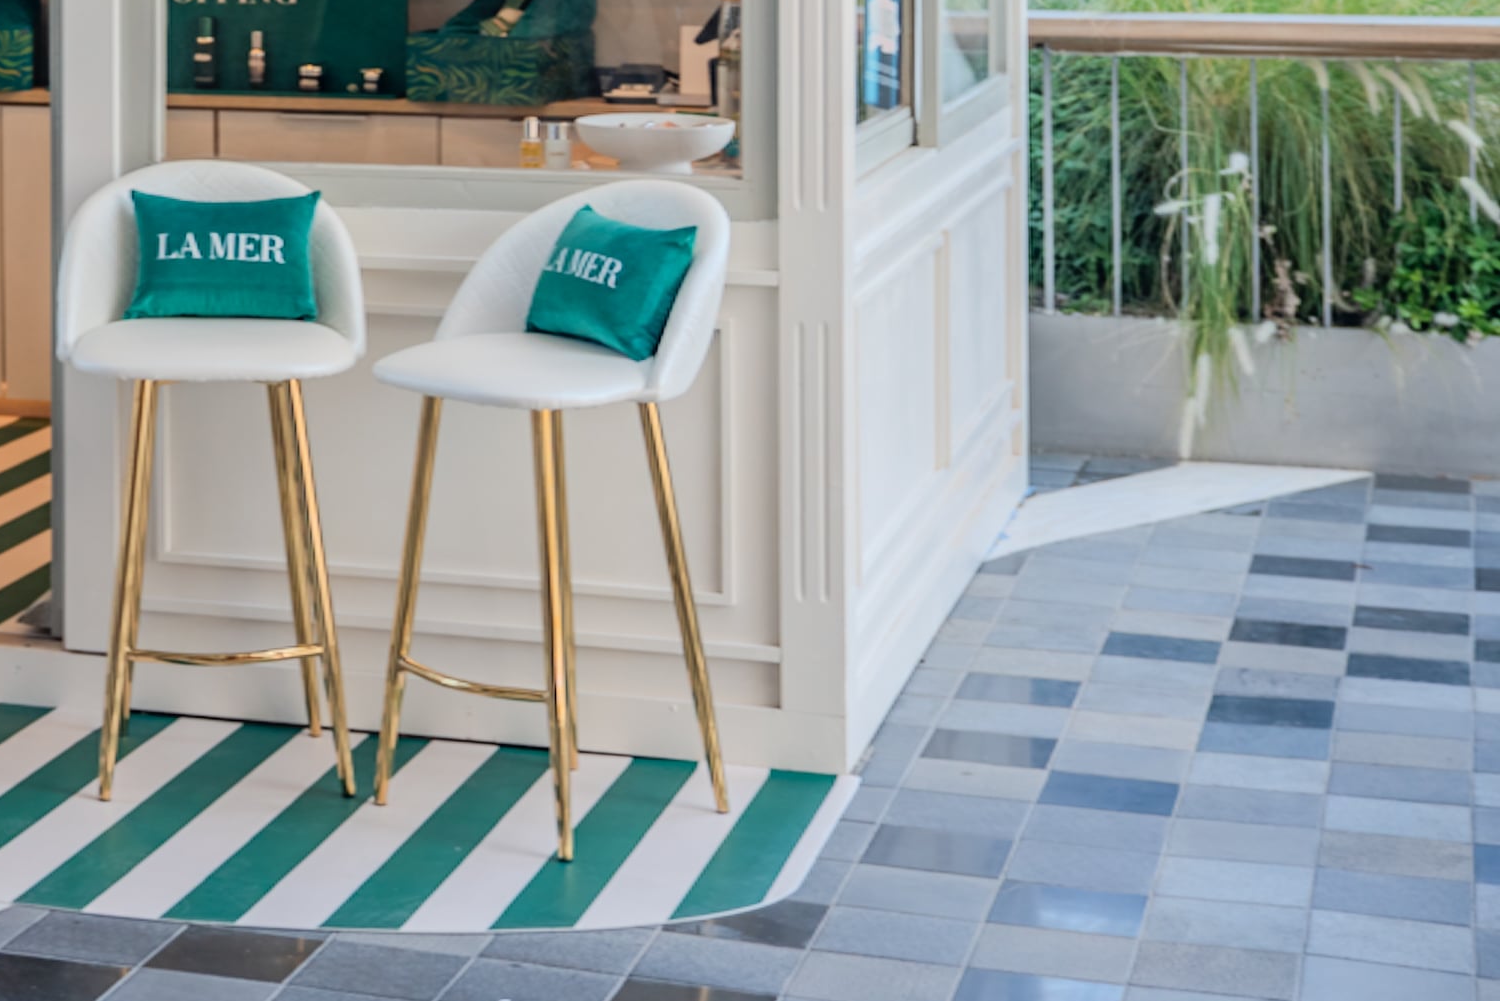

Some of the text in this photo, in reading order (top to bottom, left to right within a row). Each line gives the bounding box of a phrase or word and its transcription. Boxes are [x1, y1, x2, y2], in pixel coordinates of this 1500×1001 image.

[156, 232, 286, 264] LA MER
[563, 249, 622, 289] MER
